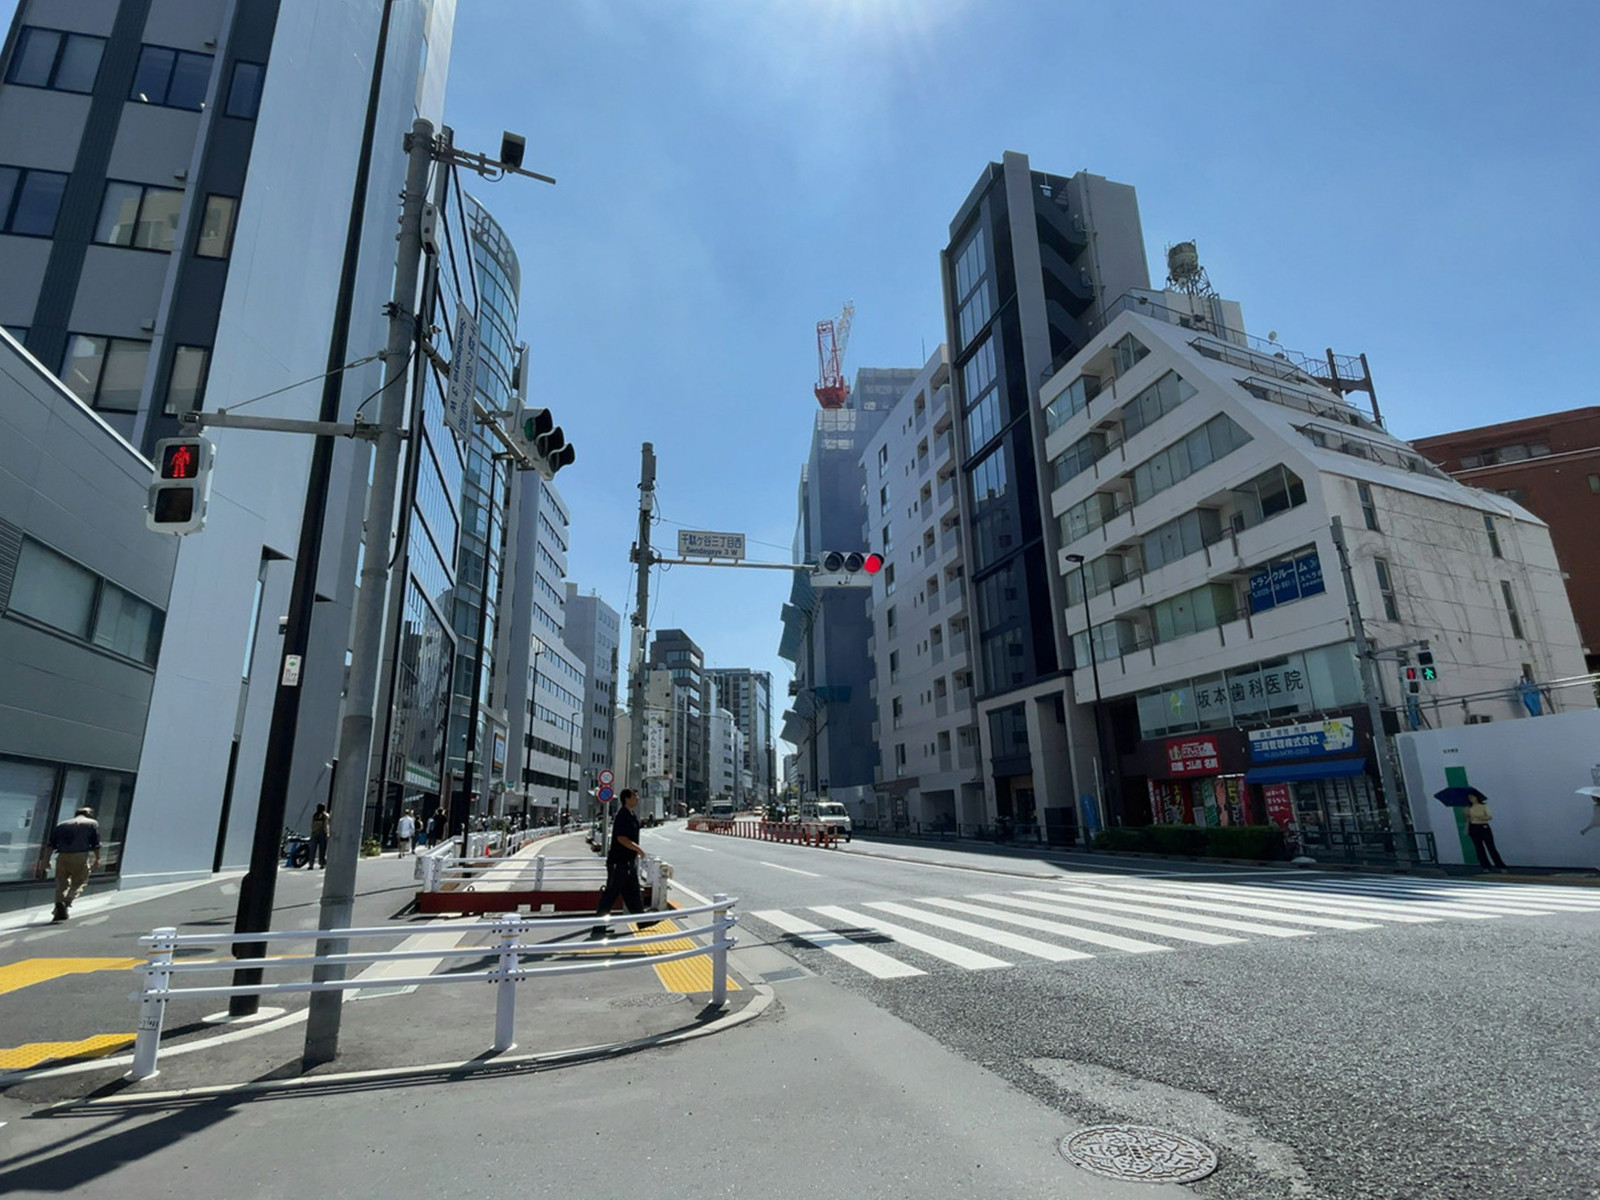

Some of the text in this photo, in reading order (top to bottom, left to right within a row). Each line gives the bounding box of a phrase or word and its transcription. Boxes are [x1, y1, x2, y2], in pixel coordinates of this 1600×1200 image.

[452, 317, 467, 382] Sendagaya
[450, 401, 458, 414] W
[686, 546, 722, 556] Sendagaya
[1250, 562, 1308, 589] トランクルーム
[1196, 669, 1304, 709] 坂本歯科医院
